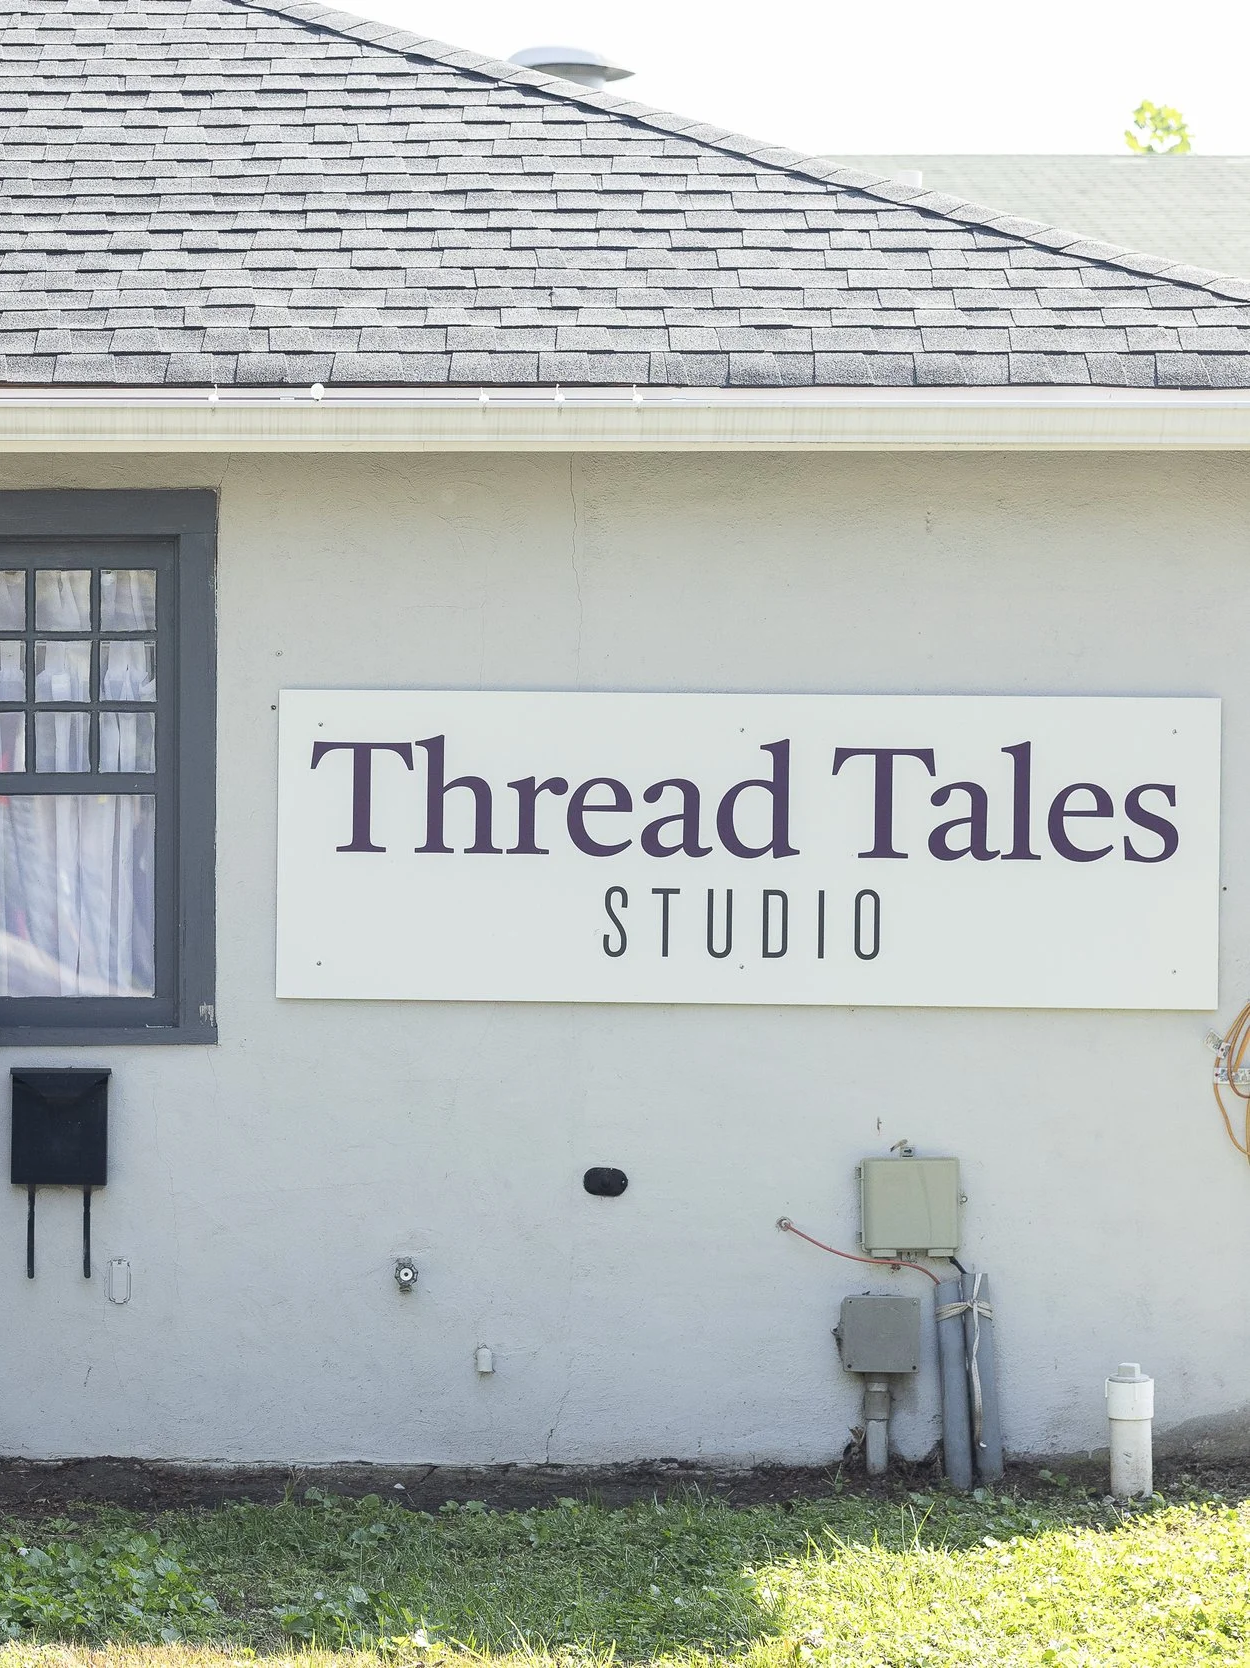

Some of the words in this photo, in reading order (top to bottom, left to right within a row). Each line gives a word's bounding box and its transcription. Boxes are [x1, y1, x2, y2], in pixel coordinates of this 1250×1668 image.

[310, 734, 801, 860] Thread
[831, 740, 1180, 864] Tales
[602, 885, 882, 961] STUDIO
